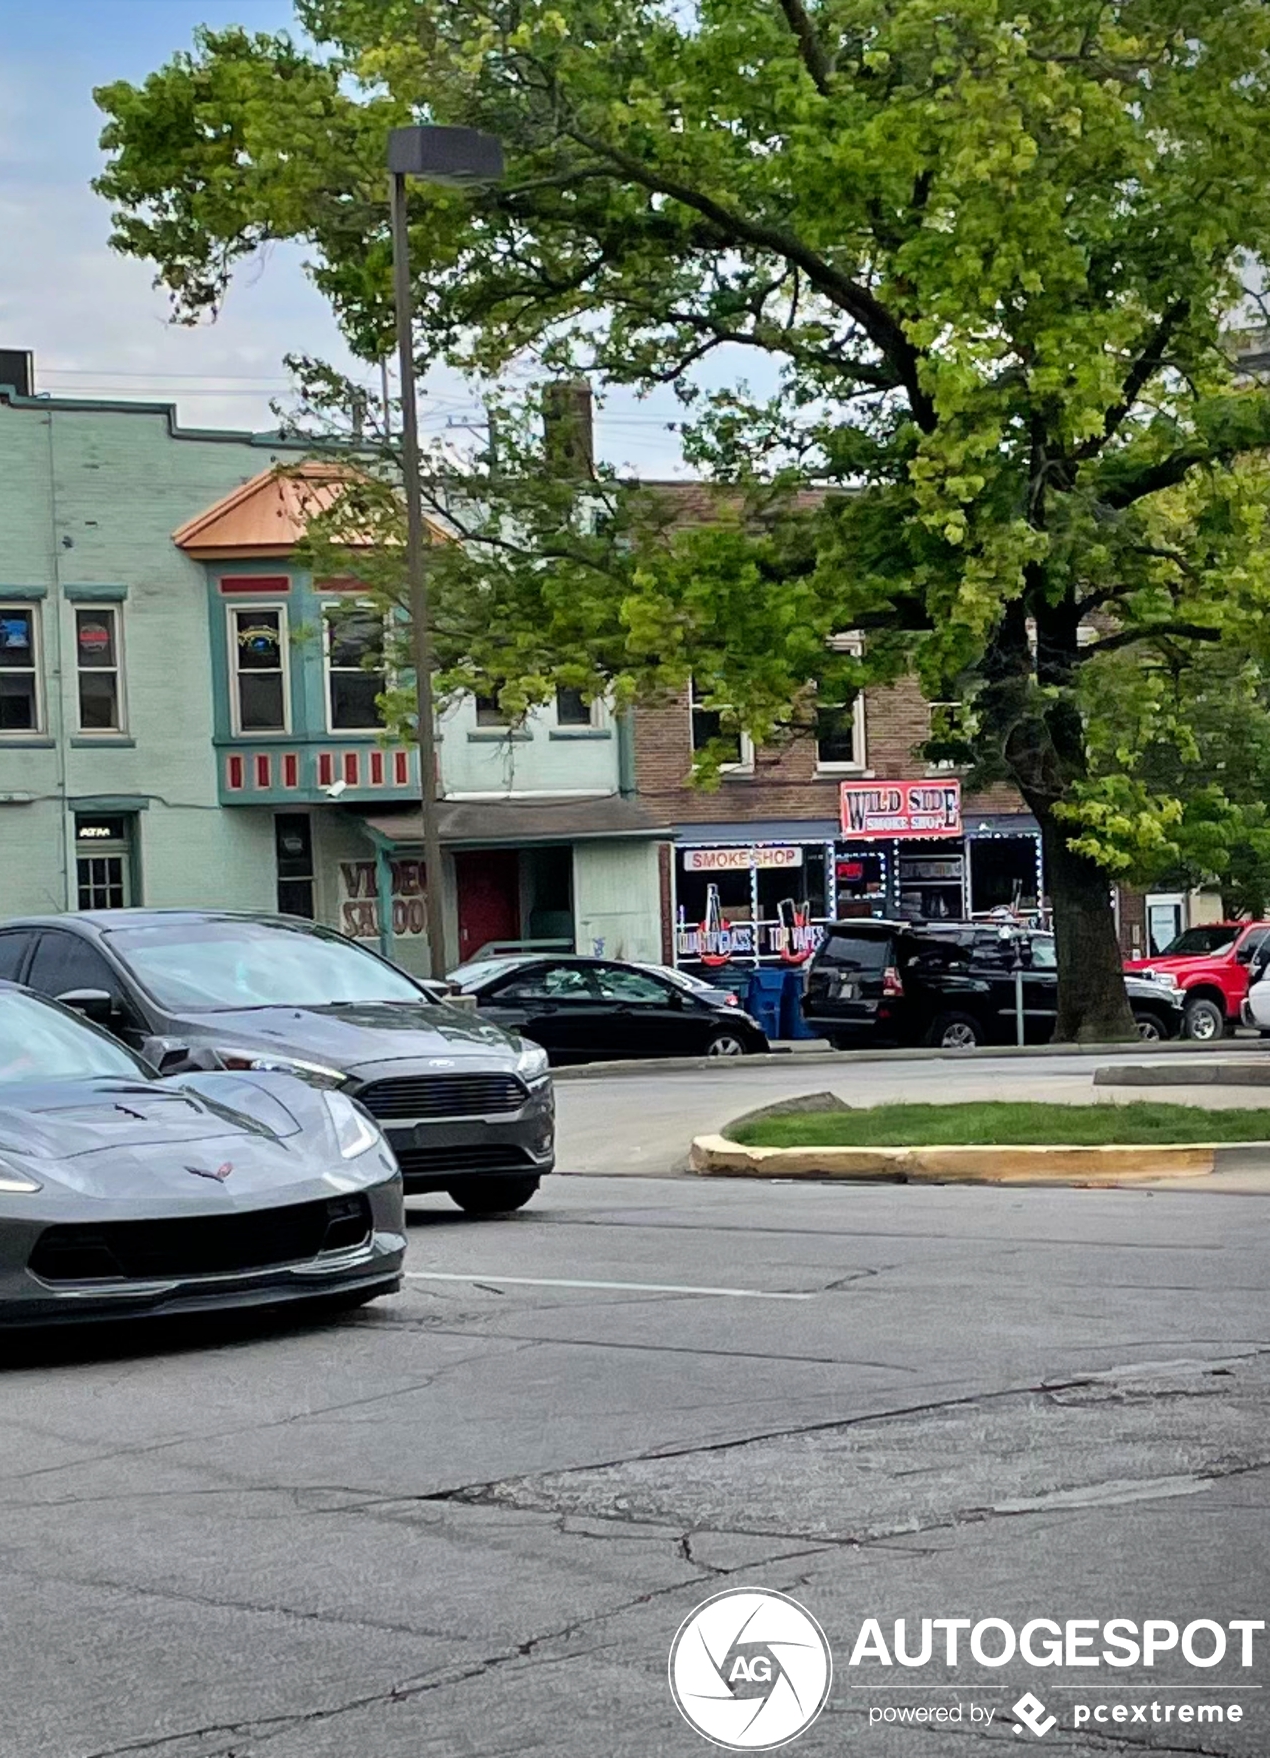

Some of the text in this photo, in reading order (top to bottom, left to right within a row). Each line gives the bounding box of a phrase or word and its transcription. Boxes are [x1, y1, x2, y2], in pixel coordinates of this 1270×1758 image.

[846, 788, 957, 831] WILD SIDE
[79, 827, 110, 837] ATM
[692, 850, 796, 868] SMOKE SHOP
[769, 925, 825, 951] TOP VAPES
